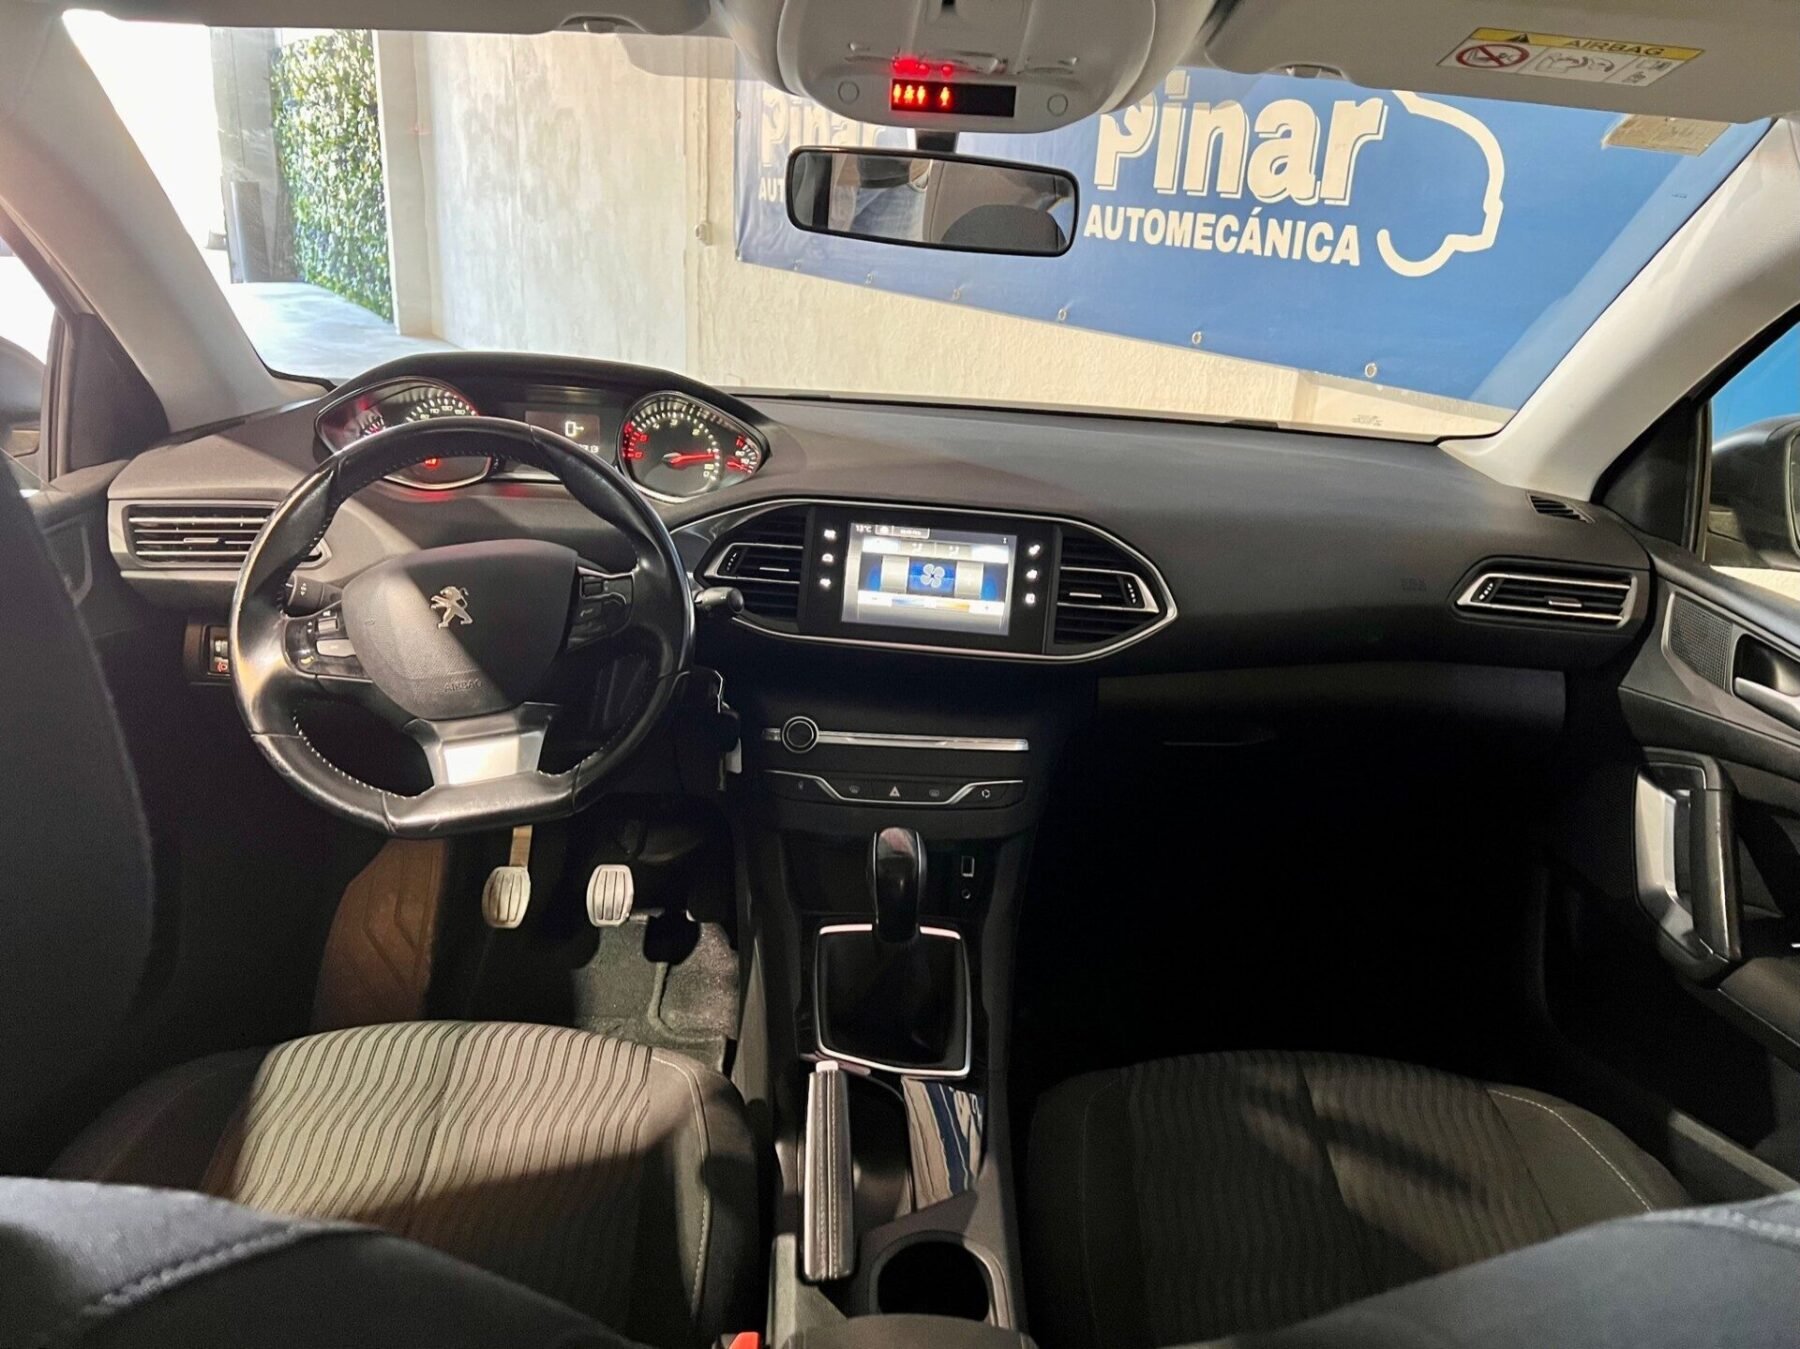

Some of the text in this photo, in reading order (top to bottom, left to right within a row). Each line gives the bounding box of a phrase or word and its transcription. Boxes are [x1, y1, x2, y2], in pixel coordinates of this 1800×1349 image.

[1565, 39, 1665, 56] AIRBAG
[1093, 69, 1389, 206] Pinar
[1083, 204, 1361, 267] AUTOMECÁNICA
